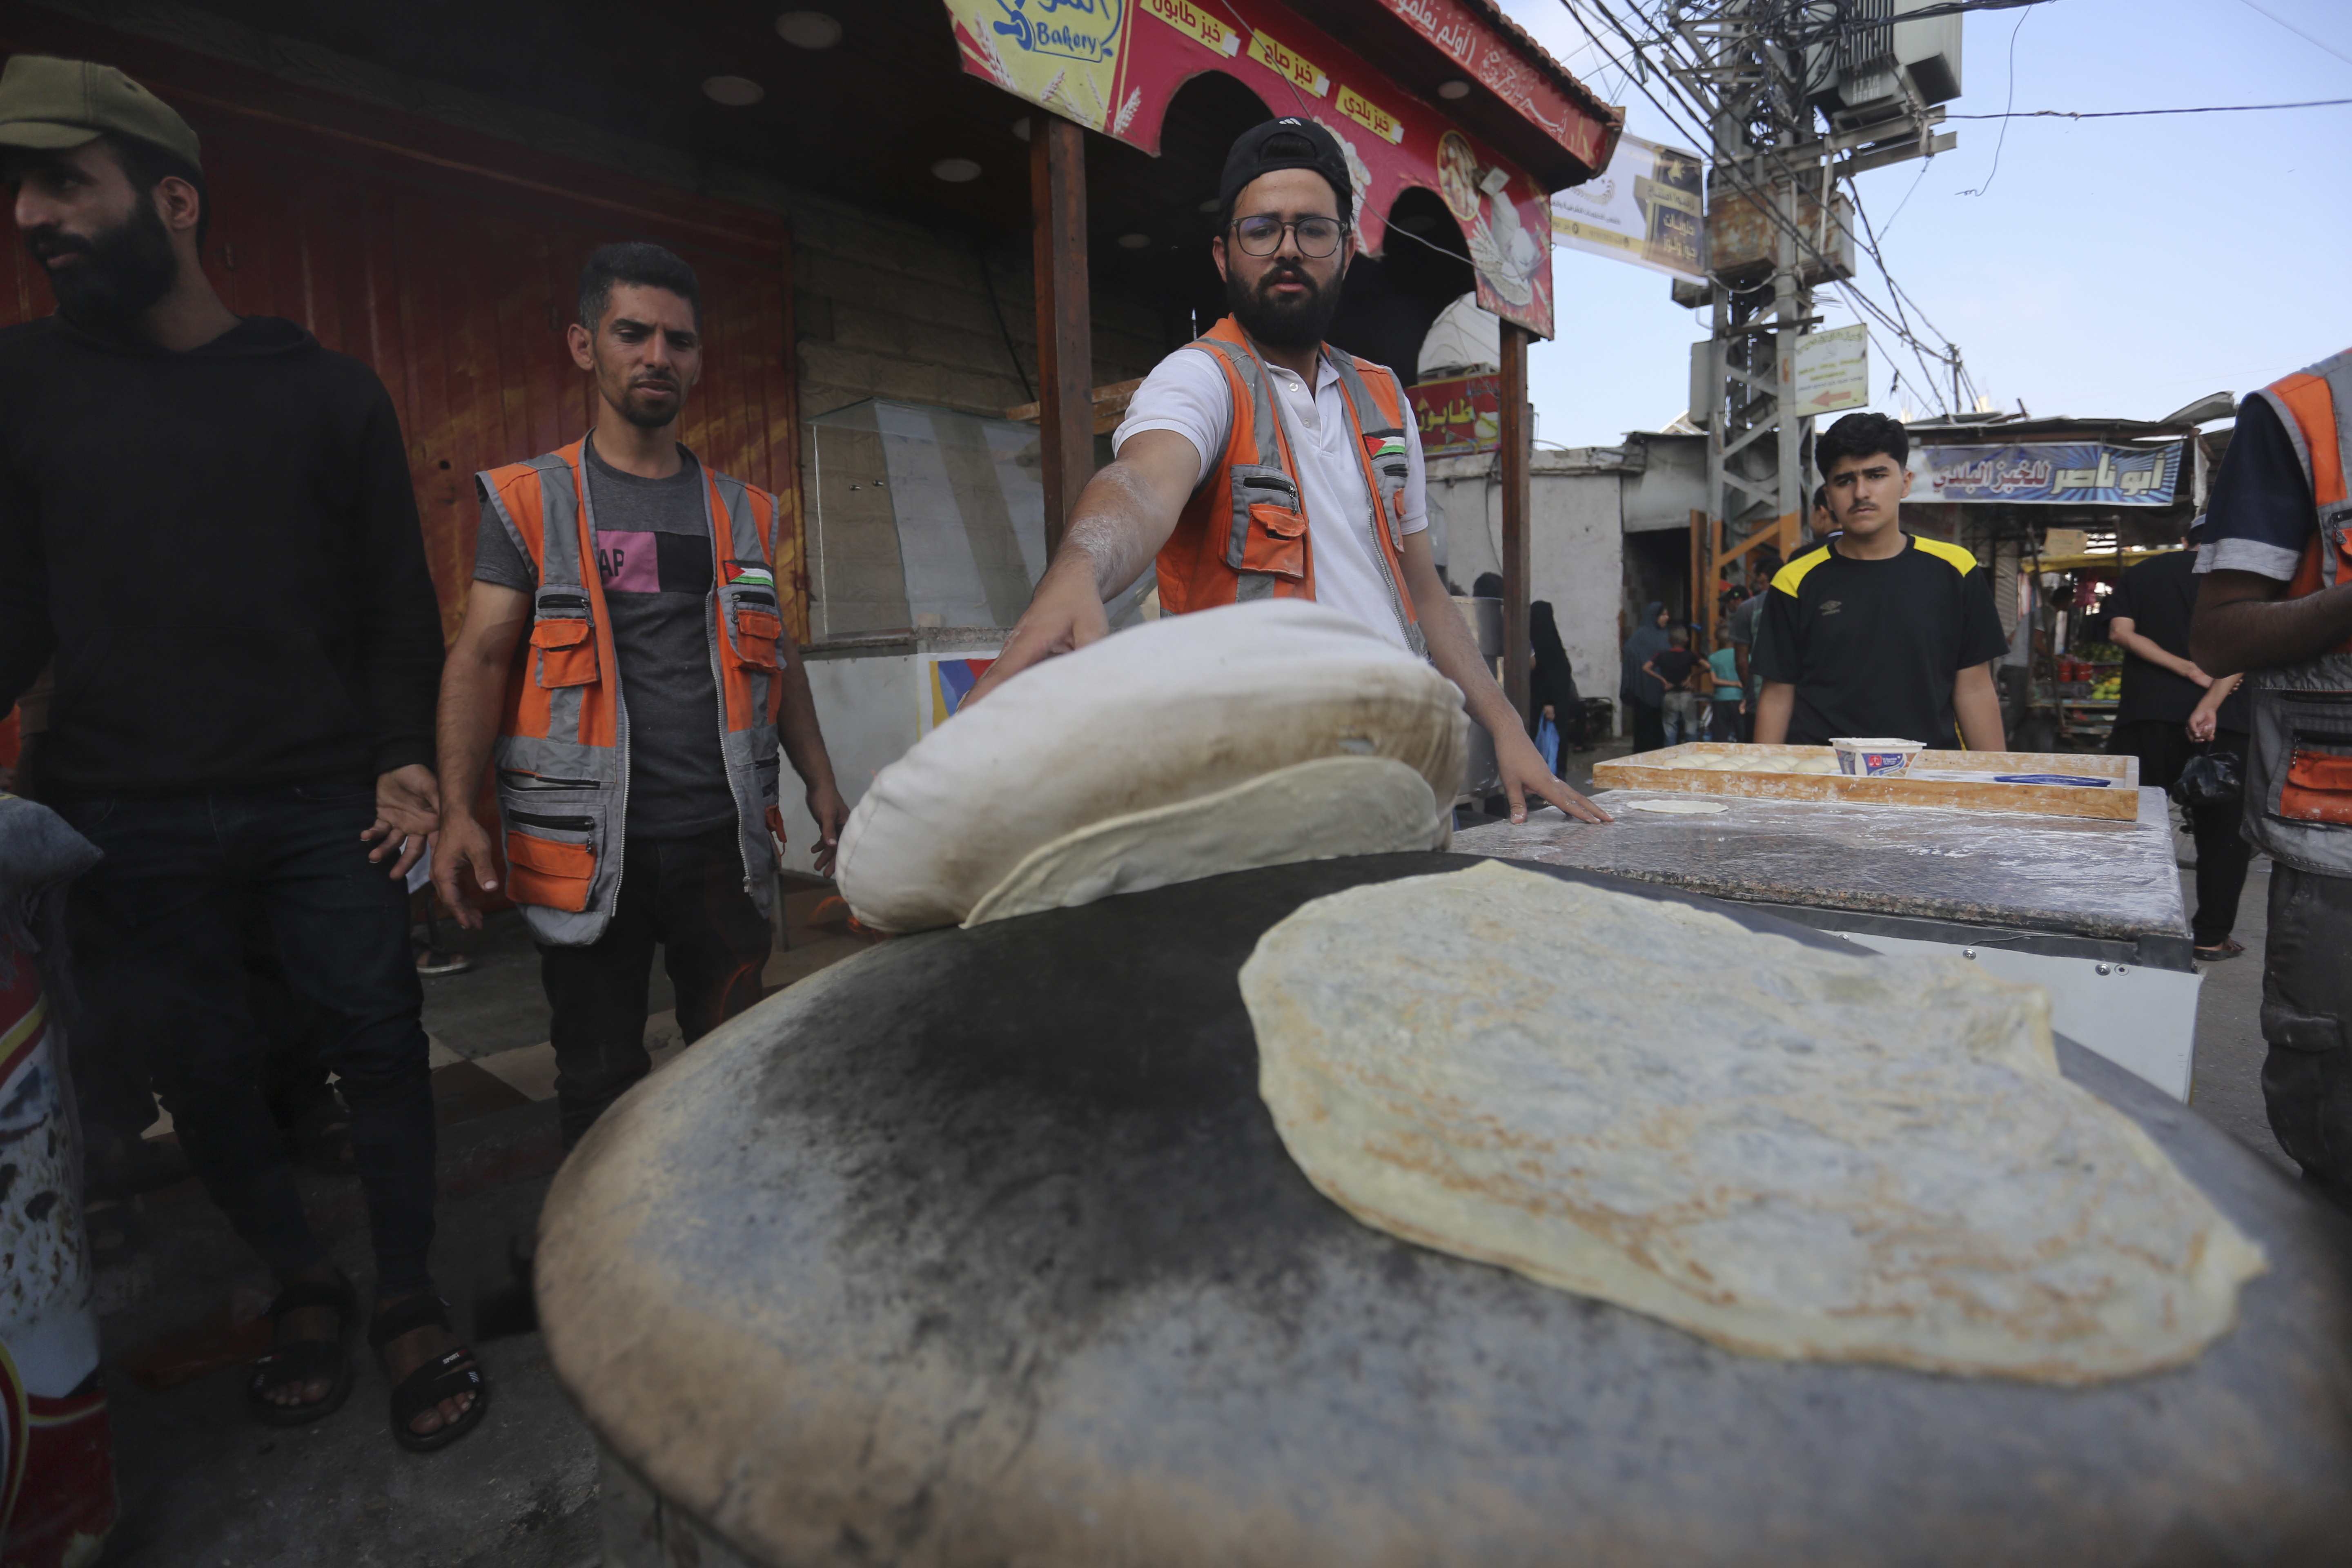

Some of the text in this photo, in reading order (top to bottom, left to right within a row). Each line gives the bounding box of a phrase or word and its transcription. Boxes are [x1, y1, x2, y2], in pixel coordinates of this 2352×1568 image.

[1036, 22, 1096, 54] Bakery
[1200, 16, 1221, 43] خبز
[1294, 58, 1312, 85] خبز
[1344, 97, 1389, 133] خبز بلدي
[1663, 213, 1695, 236] حلويات
[1932, 452, 2166, 496] أبو ناصر للخبز البلدي
[443, 1352, 460, 1364] SPORT
